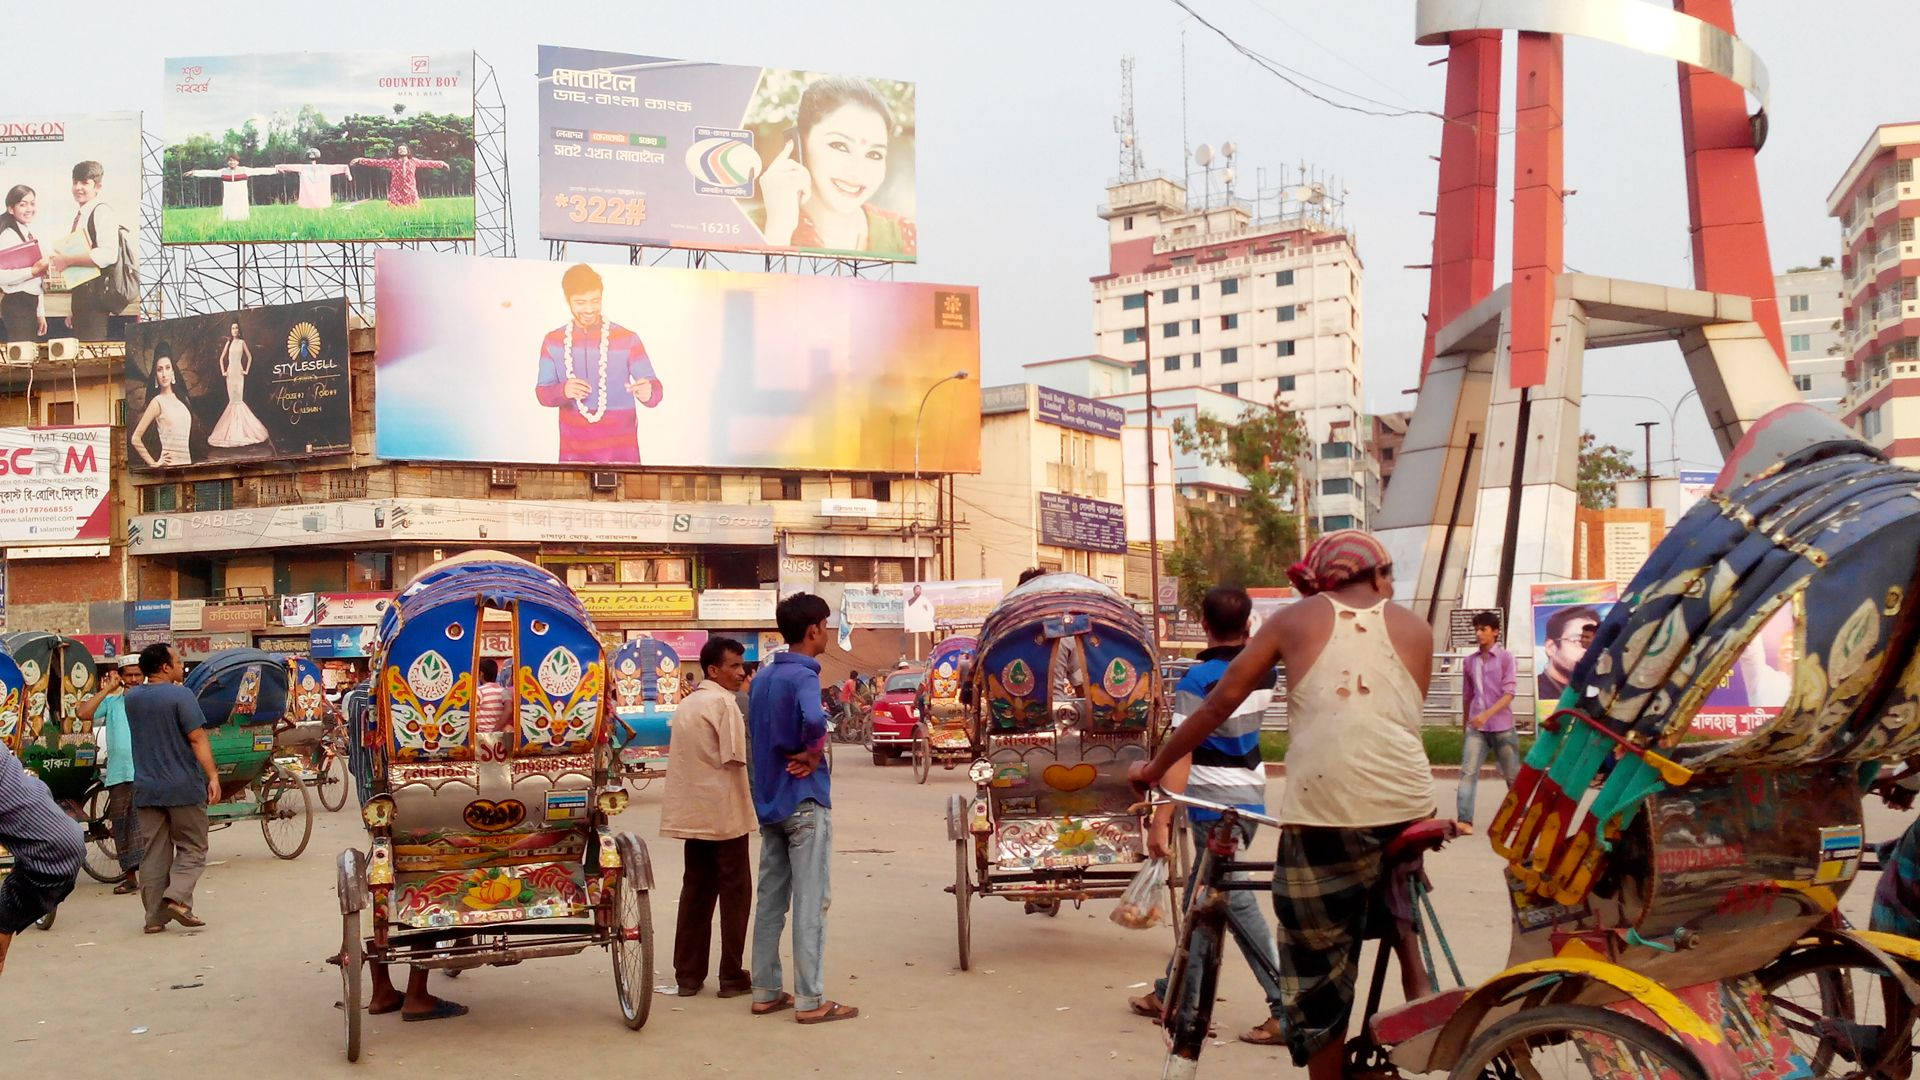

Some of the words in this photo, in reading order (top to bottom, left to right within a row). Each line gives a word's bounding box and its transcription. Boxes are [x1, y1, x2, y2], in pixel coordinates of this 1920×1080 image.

[182, 66, 203, 82] শুভ
[552, 68, 637, 93] মোবাইলে
[379, 77, 432, 88] COUNTRY
[436, 77, 458, 87] BOY
[40, 121, 65, 135] ON
[554, 144, 582, 158] সবই
[585, 147, 613, 161] এখন
[616, 149, 665, 165] মোবাইলে
[701, 222, 741, 235] 16216
[272, 359, 338, 377] STYLESELL
[32, 433, 57, 443] TMT
[61, 431, 97, 442] 500W
[19, 506, 73, 514] 01787668555
[190, 511, 255, 529] CABLES
[615, 593, 690, 604] PALACE
[42, 757, 73, 772] হারুন
